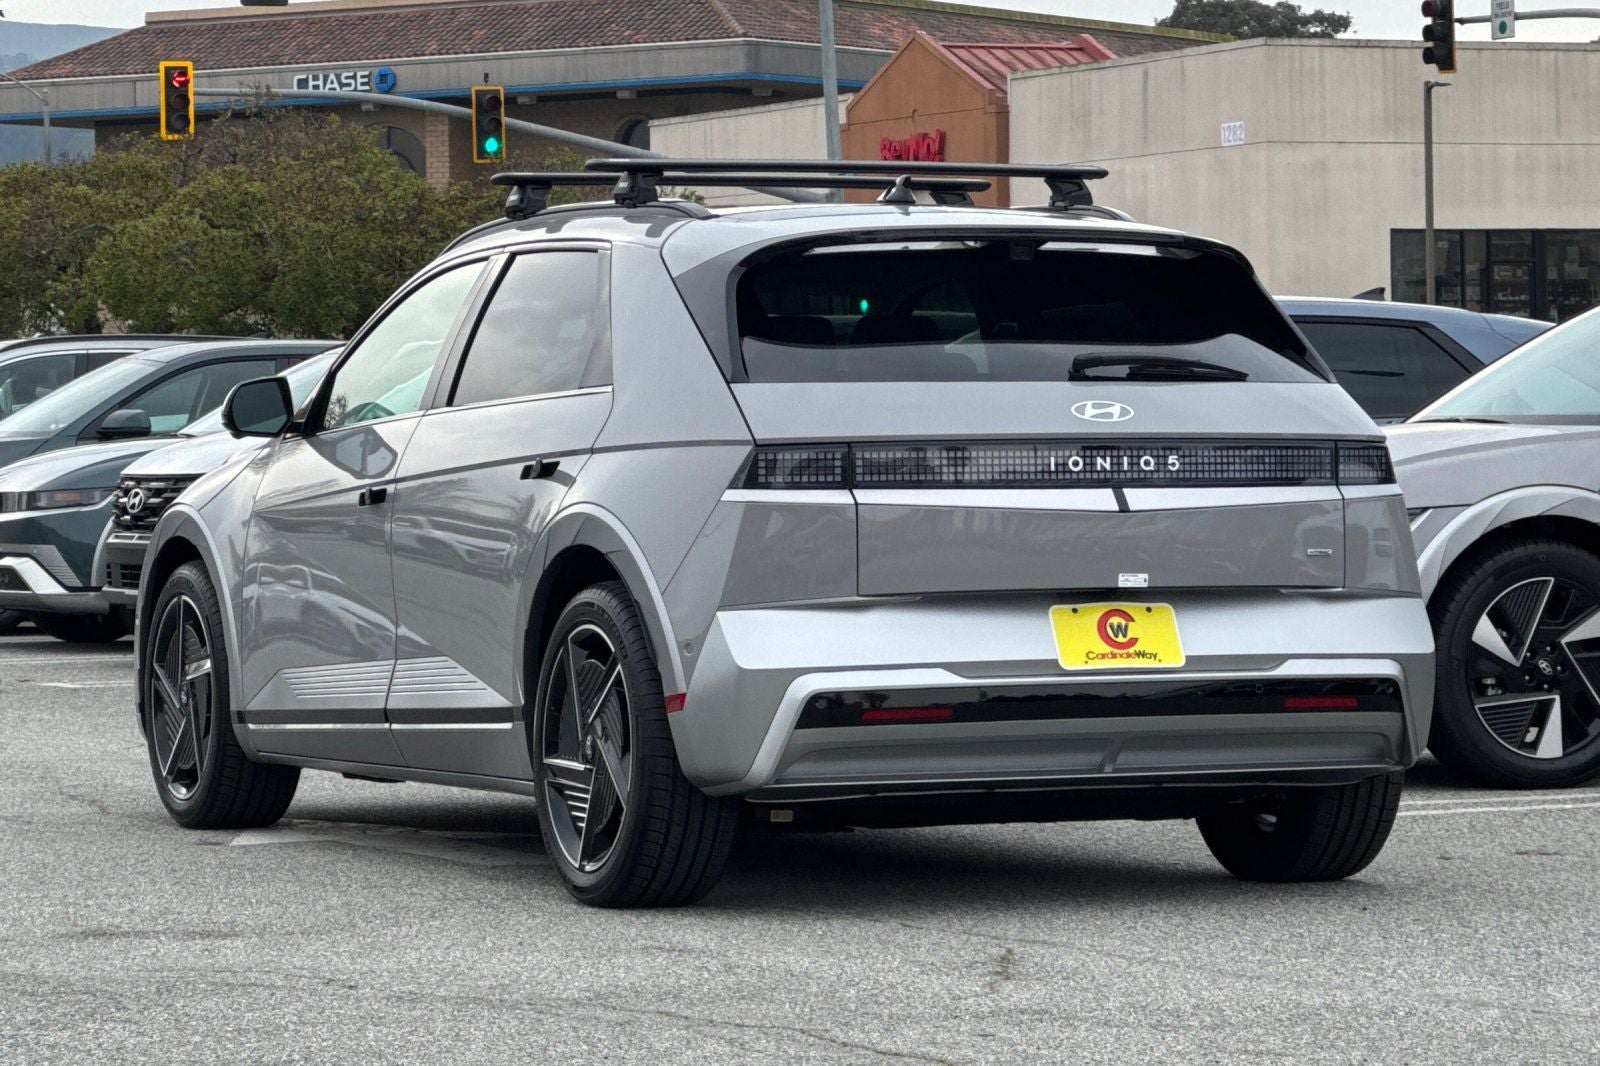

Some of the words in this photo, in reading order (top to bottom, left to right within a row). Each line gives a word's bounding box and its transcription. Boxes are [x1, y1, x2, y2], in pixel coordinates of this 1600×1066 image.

[293, 71, 371, 91] CHASE
[1222, 124, 1244, 144] 1282
[1050, 456, 1155, 471] IONIQ
[1167, 455, 1180, 471] 5
